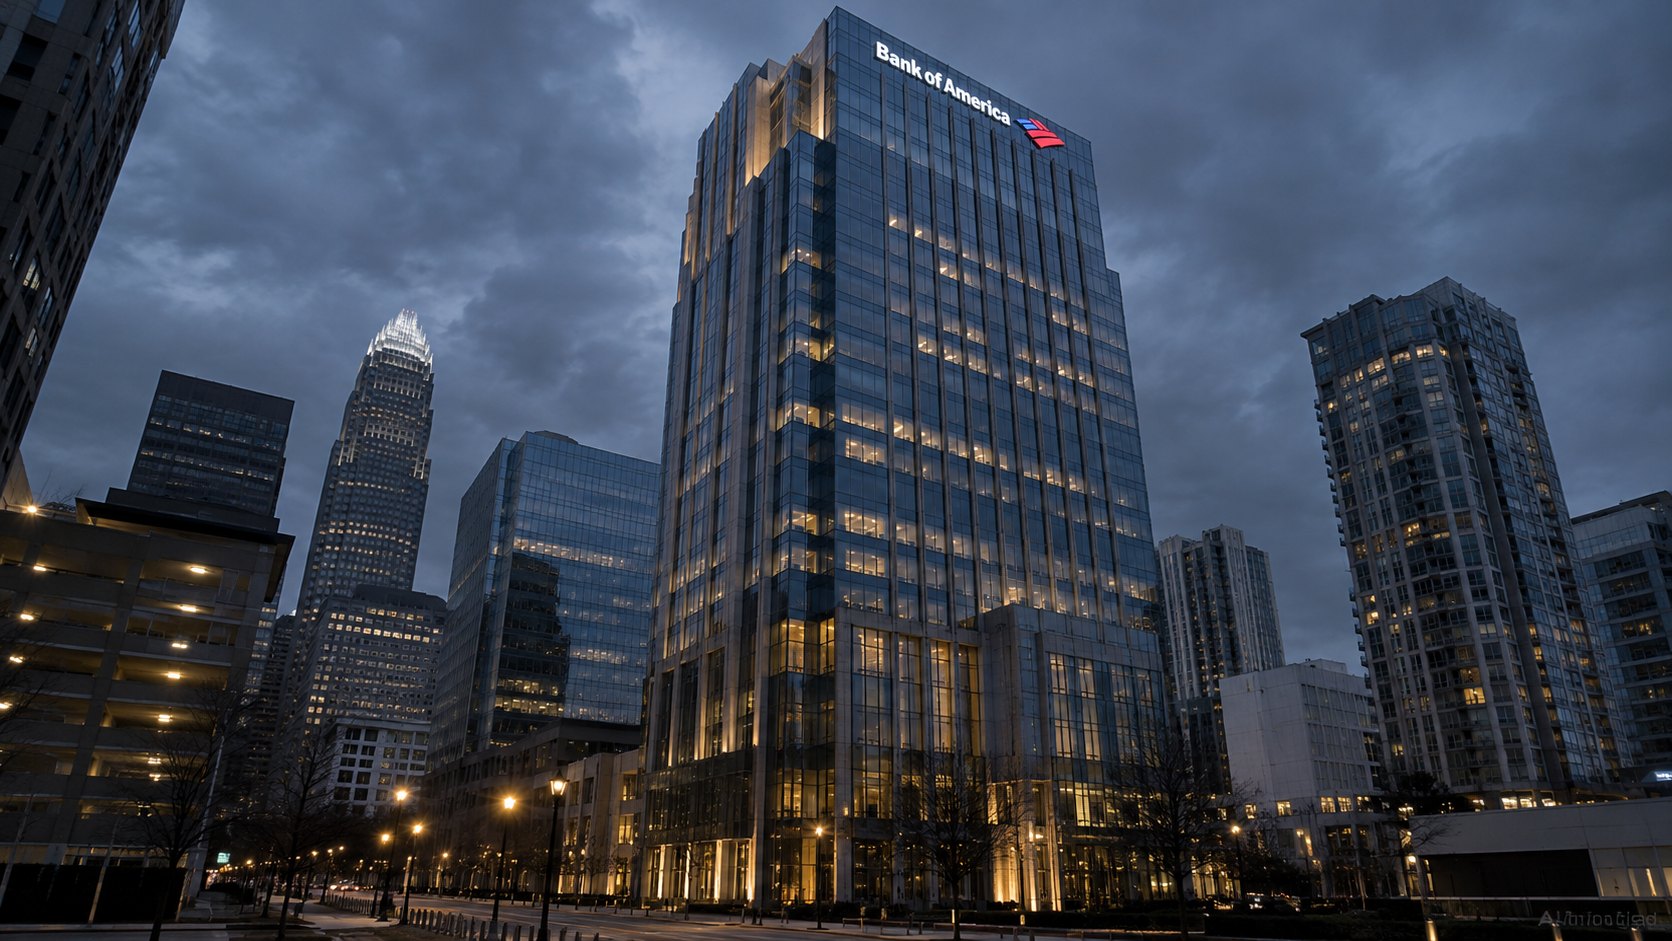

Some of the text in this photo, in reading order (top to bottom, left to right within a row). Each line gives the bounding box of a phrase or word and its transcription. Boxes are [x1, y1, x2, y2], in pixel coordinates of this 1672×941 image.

[876, 41, 1011, 126] Bank of America
